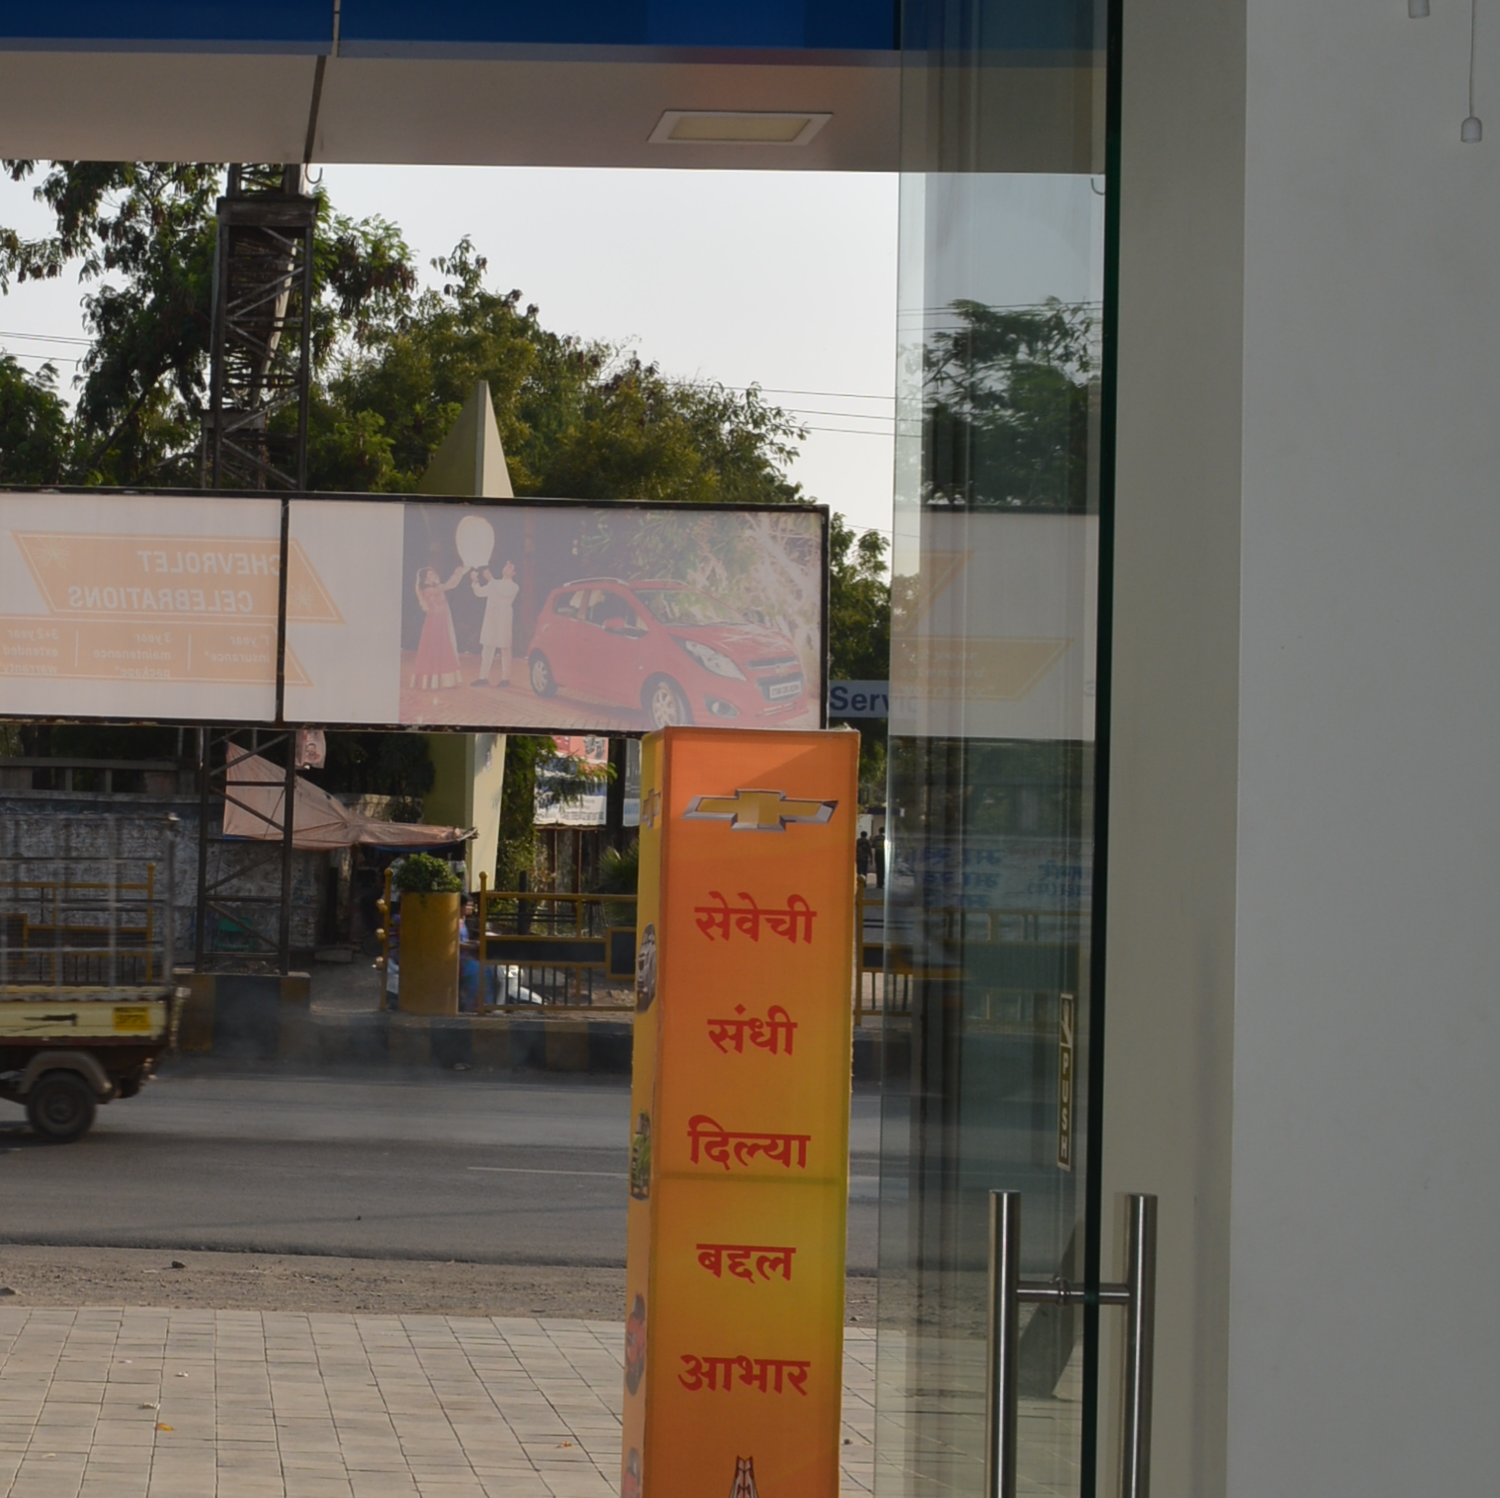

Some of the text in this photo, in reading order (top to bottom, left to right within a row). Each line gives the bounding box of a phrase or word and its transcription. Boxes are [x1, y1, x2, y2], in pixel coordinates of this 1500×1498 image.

[694, 890, 817, 945] सेवेची
[706, 1003, 798, 1056] संधी
[1061, 1051, 1069, 1158] PUSH
[686, 1114, 812, 1171] दिल्या
[695, 1243, 797, 1285] बद्दल
[677, 1354, 811, 1397] आभार
